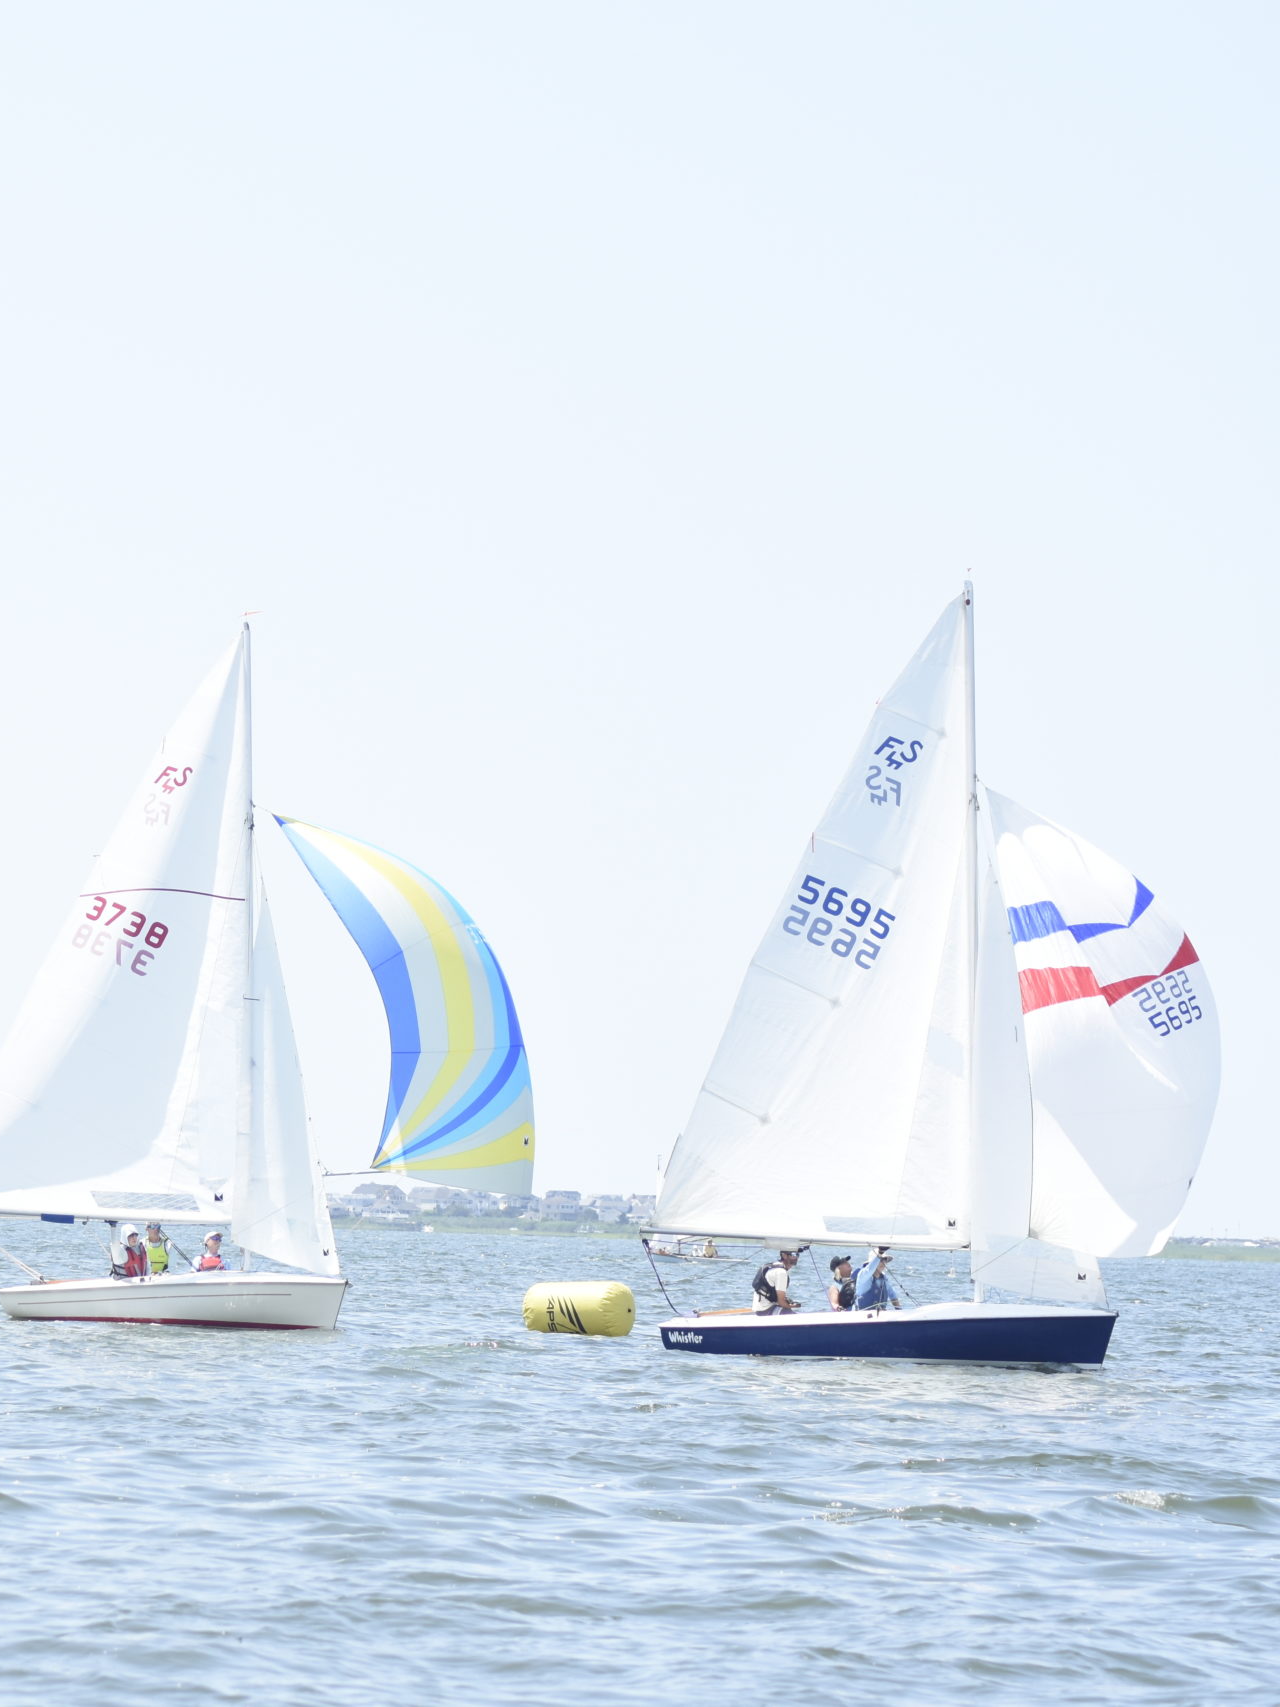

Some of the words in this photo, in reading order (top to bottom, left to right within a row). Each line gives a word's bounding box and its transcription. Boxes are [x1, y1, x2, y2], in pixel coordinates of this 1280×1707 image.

[85, 895, 169, 949] 3738
[797, 874, 896, 940] 5695
[1148, 995, 1202, 1037] 5695
[668, 1331, 703, 1344] Whistler
